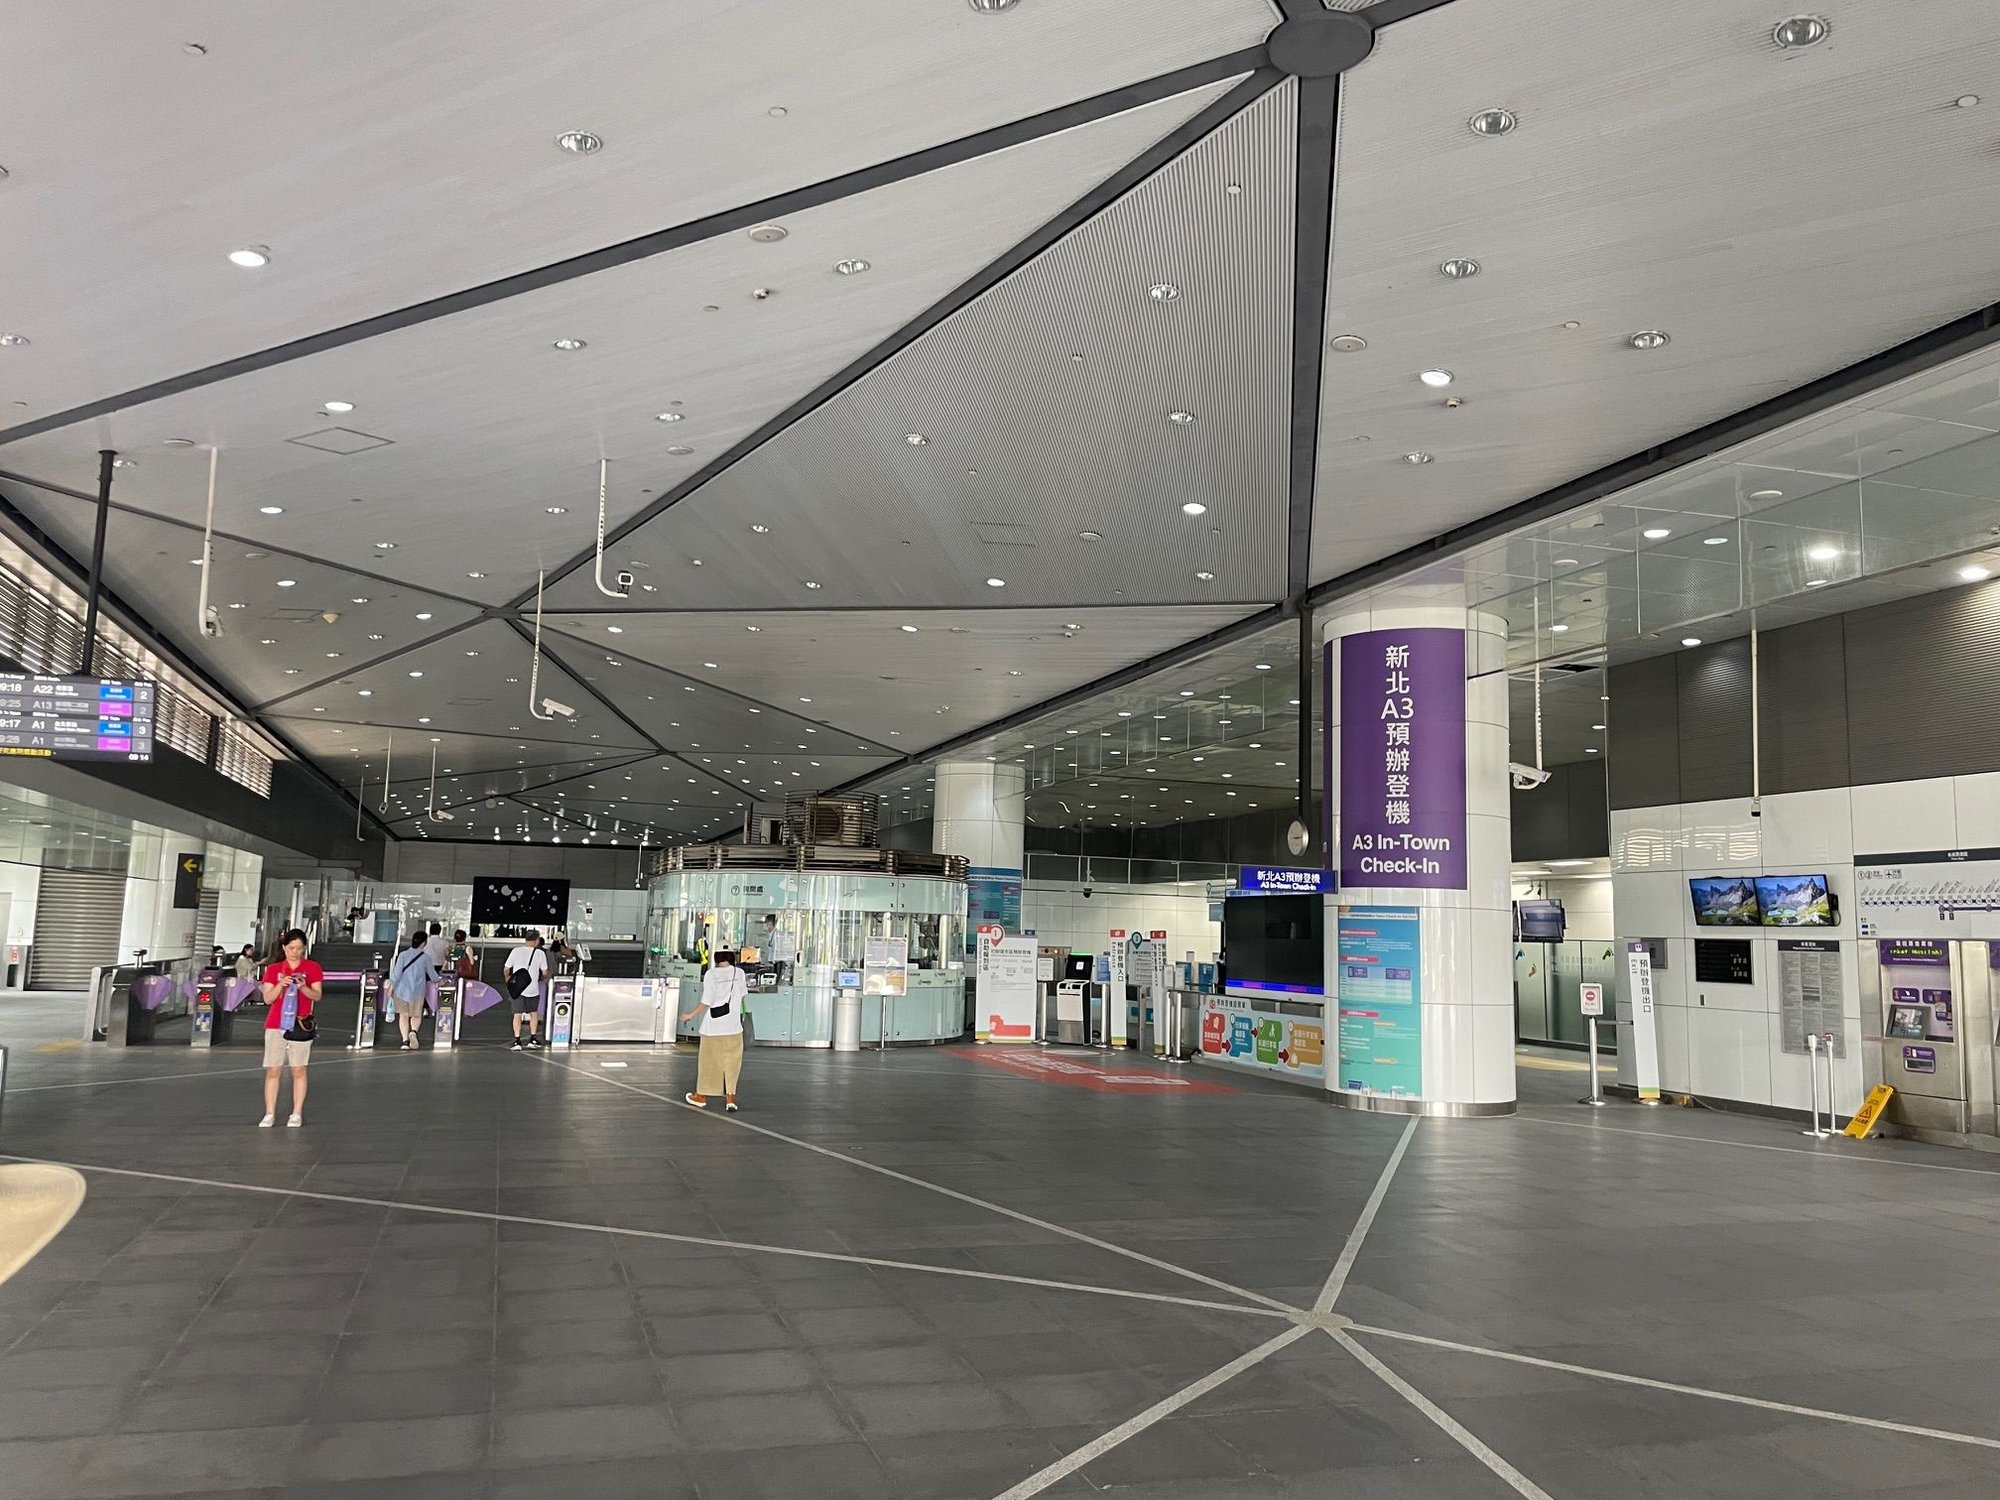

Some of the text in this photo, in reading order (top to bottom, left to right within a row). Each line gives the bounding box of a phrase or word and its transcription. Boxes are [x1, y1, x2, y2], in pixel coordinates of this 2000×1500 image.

[33, 684, 54, 694] A22
[140, 691, 148, 700] 2
[32, 700, 53, 710] A13
[32, 720, 45, 729] A1
[138, 725, 147, 735] 3
[1381, 644, 1415, 825] 新北A3預辦登機
[1352, 833, 1450, 851] A3 In-Town
[1360, 856, 1440, 875] Check-In
